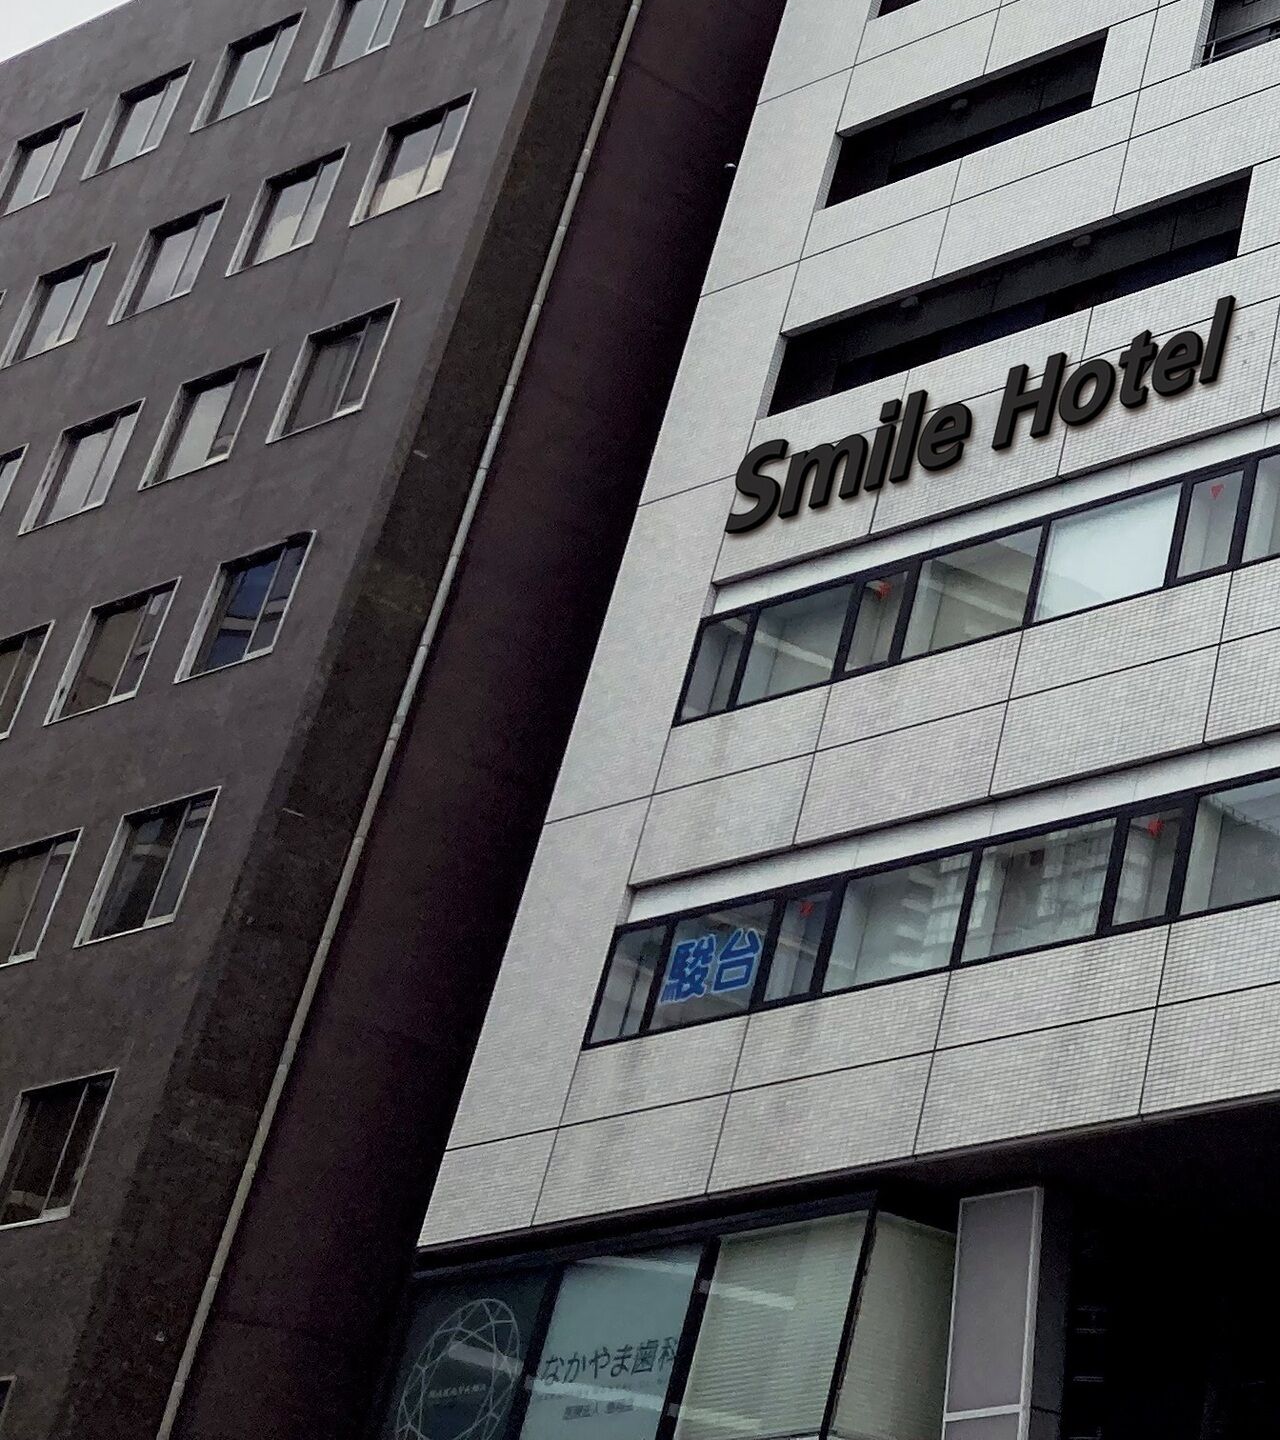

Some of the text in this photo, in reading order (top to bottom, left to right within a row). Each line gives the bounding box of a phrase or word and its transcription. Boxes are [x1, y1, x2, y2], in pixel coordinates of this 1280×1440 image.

[724, 295, 1236, 534] Smile Hotel
[658, 928, 762, 1004] 駿台
